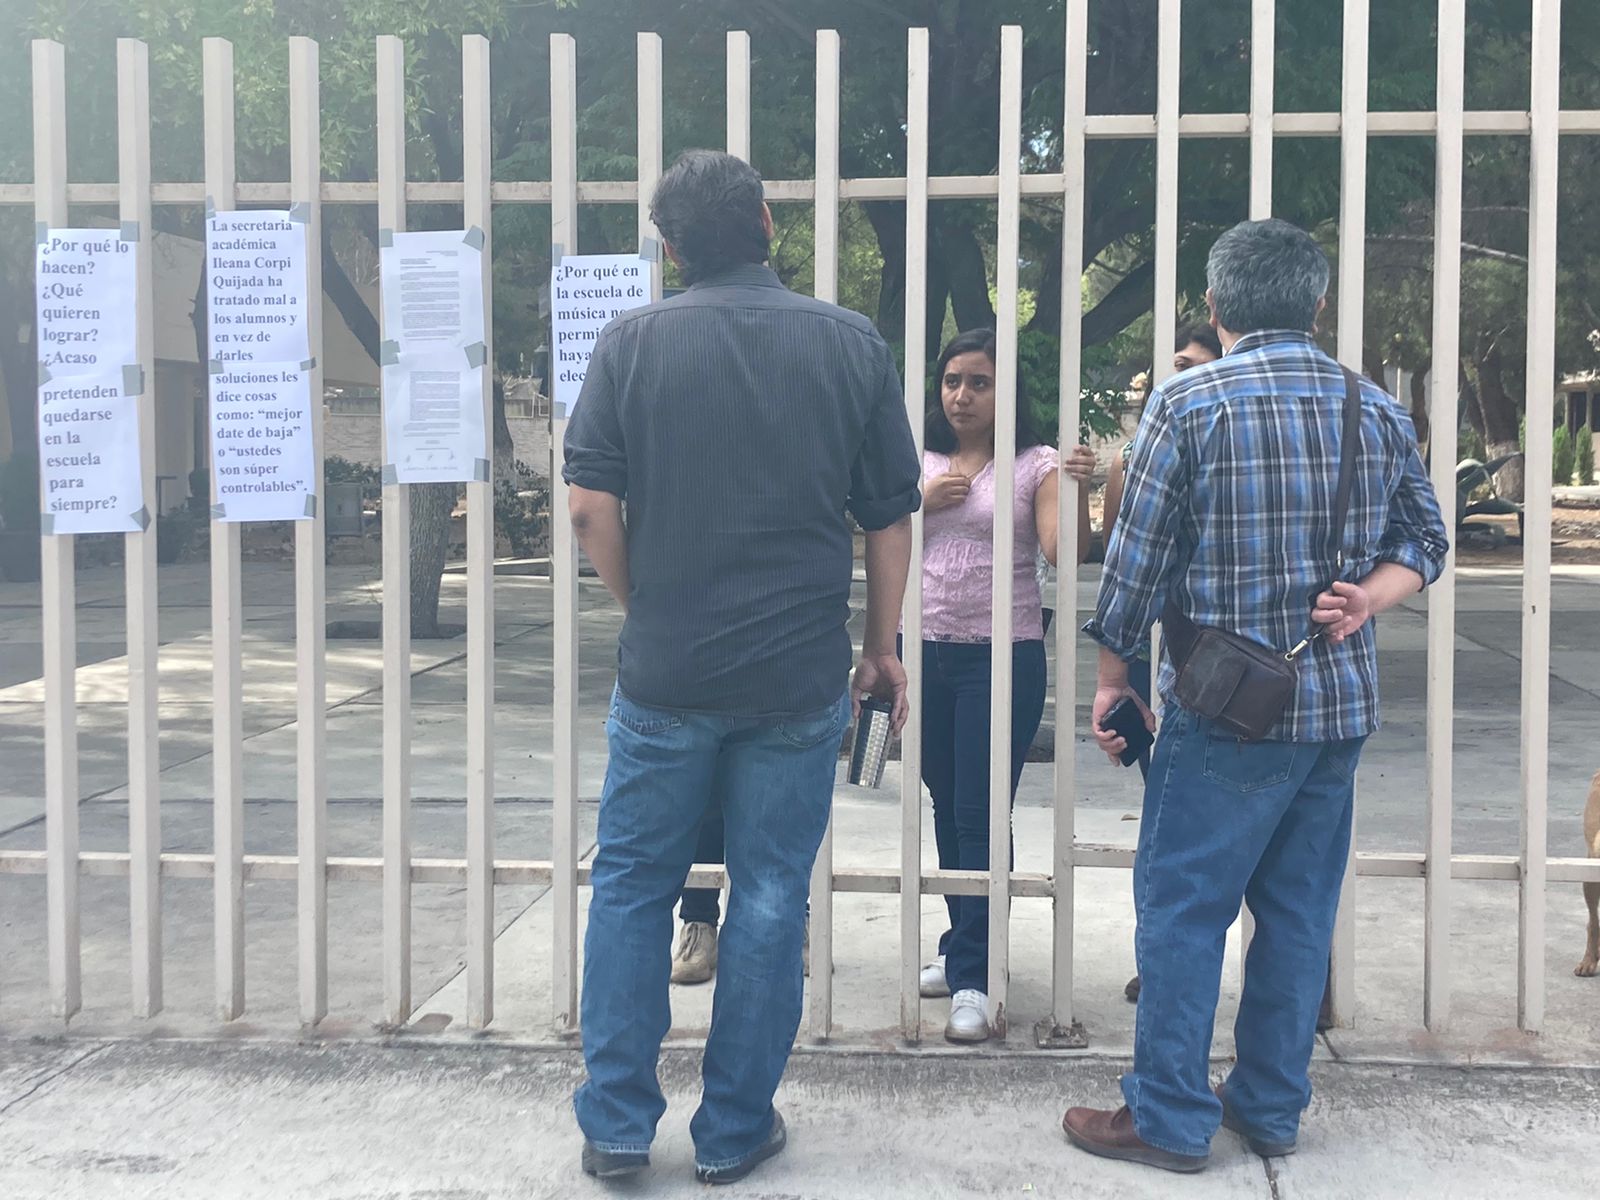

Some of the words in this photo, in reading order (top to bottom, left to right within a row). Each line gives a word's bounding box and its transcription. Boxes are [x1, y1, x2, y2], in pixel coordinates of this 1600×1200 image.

[212, 220, 228, 231] La
[232, 220, 292, 231] secretaria
[42, 238, 78, 255] ¿Por
[83, 240, 111, 255] qué
[116, 240, 128, 253] lo
[212, 238, 276, 250] académica
[42, 261, 95, 274] hacen?
[213, 258, 250, 268] Ileana
[254, 257, 291, 270] Corpi
[556, 266, 589, 281] ¿Por
[594, 265, 619, 280] qué
[623, 267, 639, 276] en
[214, 276, 264, 289] Quijada
[268, 276, 282, 286] ha
[42, 283, 84, 299] ¿Qué
[557, 287, 568, 299] la
[574, 286, 622, 298] escuela
[627, 286, 643, 297] de
[214, 294, 260, 305] tratado
[264, 294, 286, 305] mal
[290, 296, 296, 305] a
[43, 306, 100, 322] quieren
[214, 313, 231, 324] los
[235, 313, 286, 324] alumnos
[290, 315, 297, 326] y
[558, 307, 606, 320] música
[43, 328, 98, 345] lograr?
[215, 334, 229, 342] en
[233, 334, 253, 342] vez
[257, 332, 271, 342] de
[559, 328, 599, 344] permi
[44, 351, 96, 366] ¿Acaso
[216, 350, 253, 360] darles
[216, 372, 278, 384] soluciones
[282, 372, 298, 382] les
[560, 370, 586, 382] elec
[44, 386, 118, 404] pretenden
[216, 392, 241, 402] dice
[245, 392, 277, 401] cosas
[44, 409, 112, 426] quedarse
[217, 410, 254, 420] como:
[44, 434, 61, 445] en
[68, 432, 80, 444] la
[217, 428, 244, 438] date
[248, 428, 262, 438] de
[218, 448, 225, 456] o
[47, 453, 101, 467] escuela
[220, 466, 240, 474] son
[244, 464, 278, 476] súper
[50, 478, 84, 492] para
[51, 496, 117, 513] siempre?
